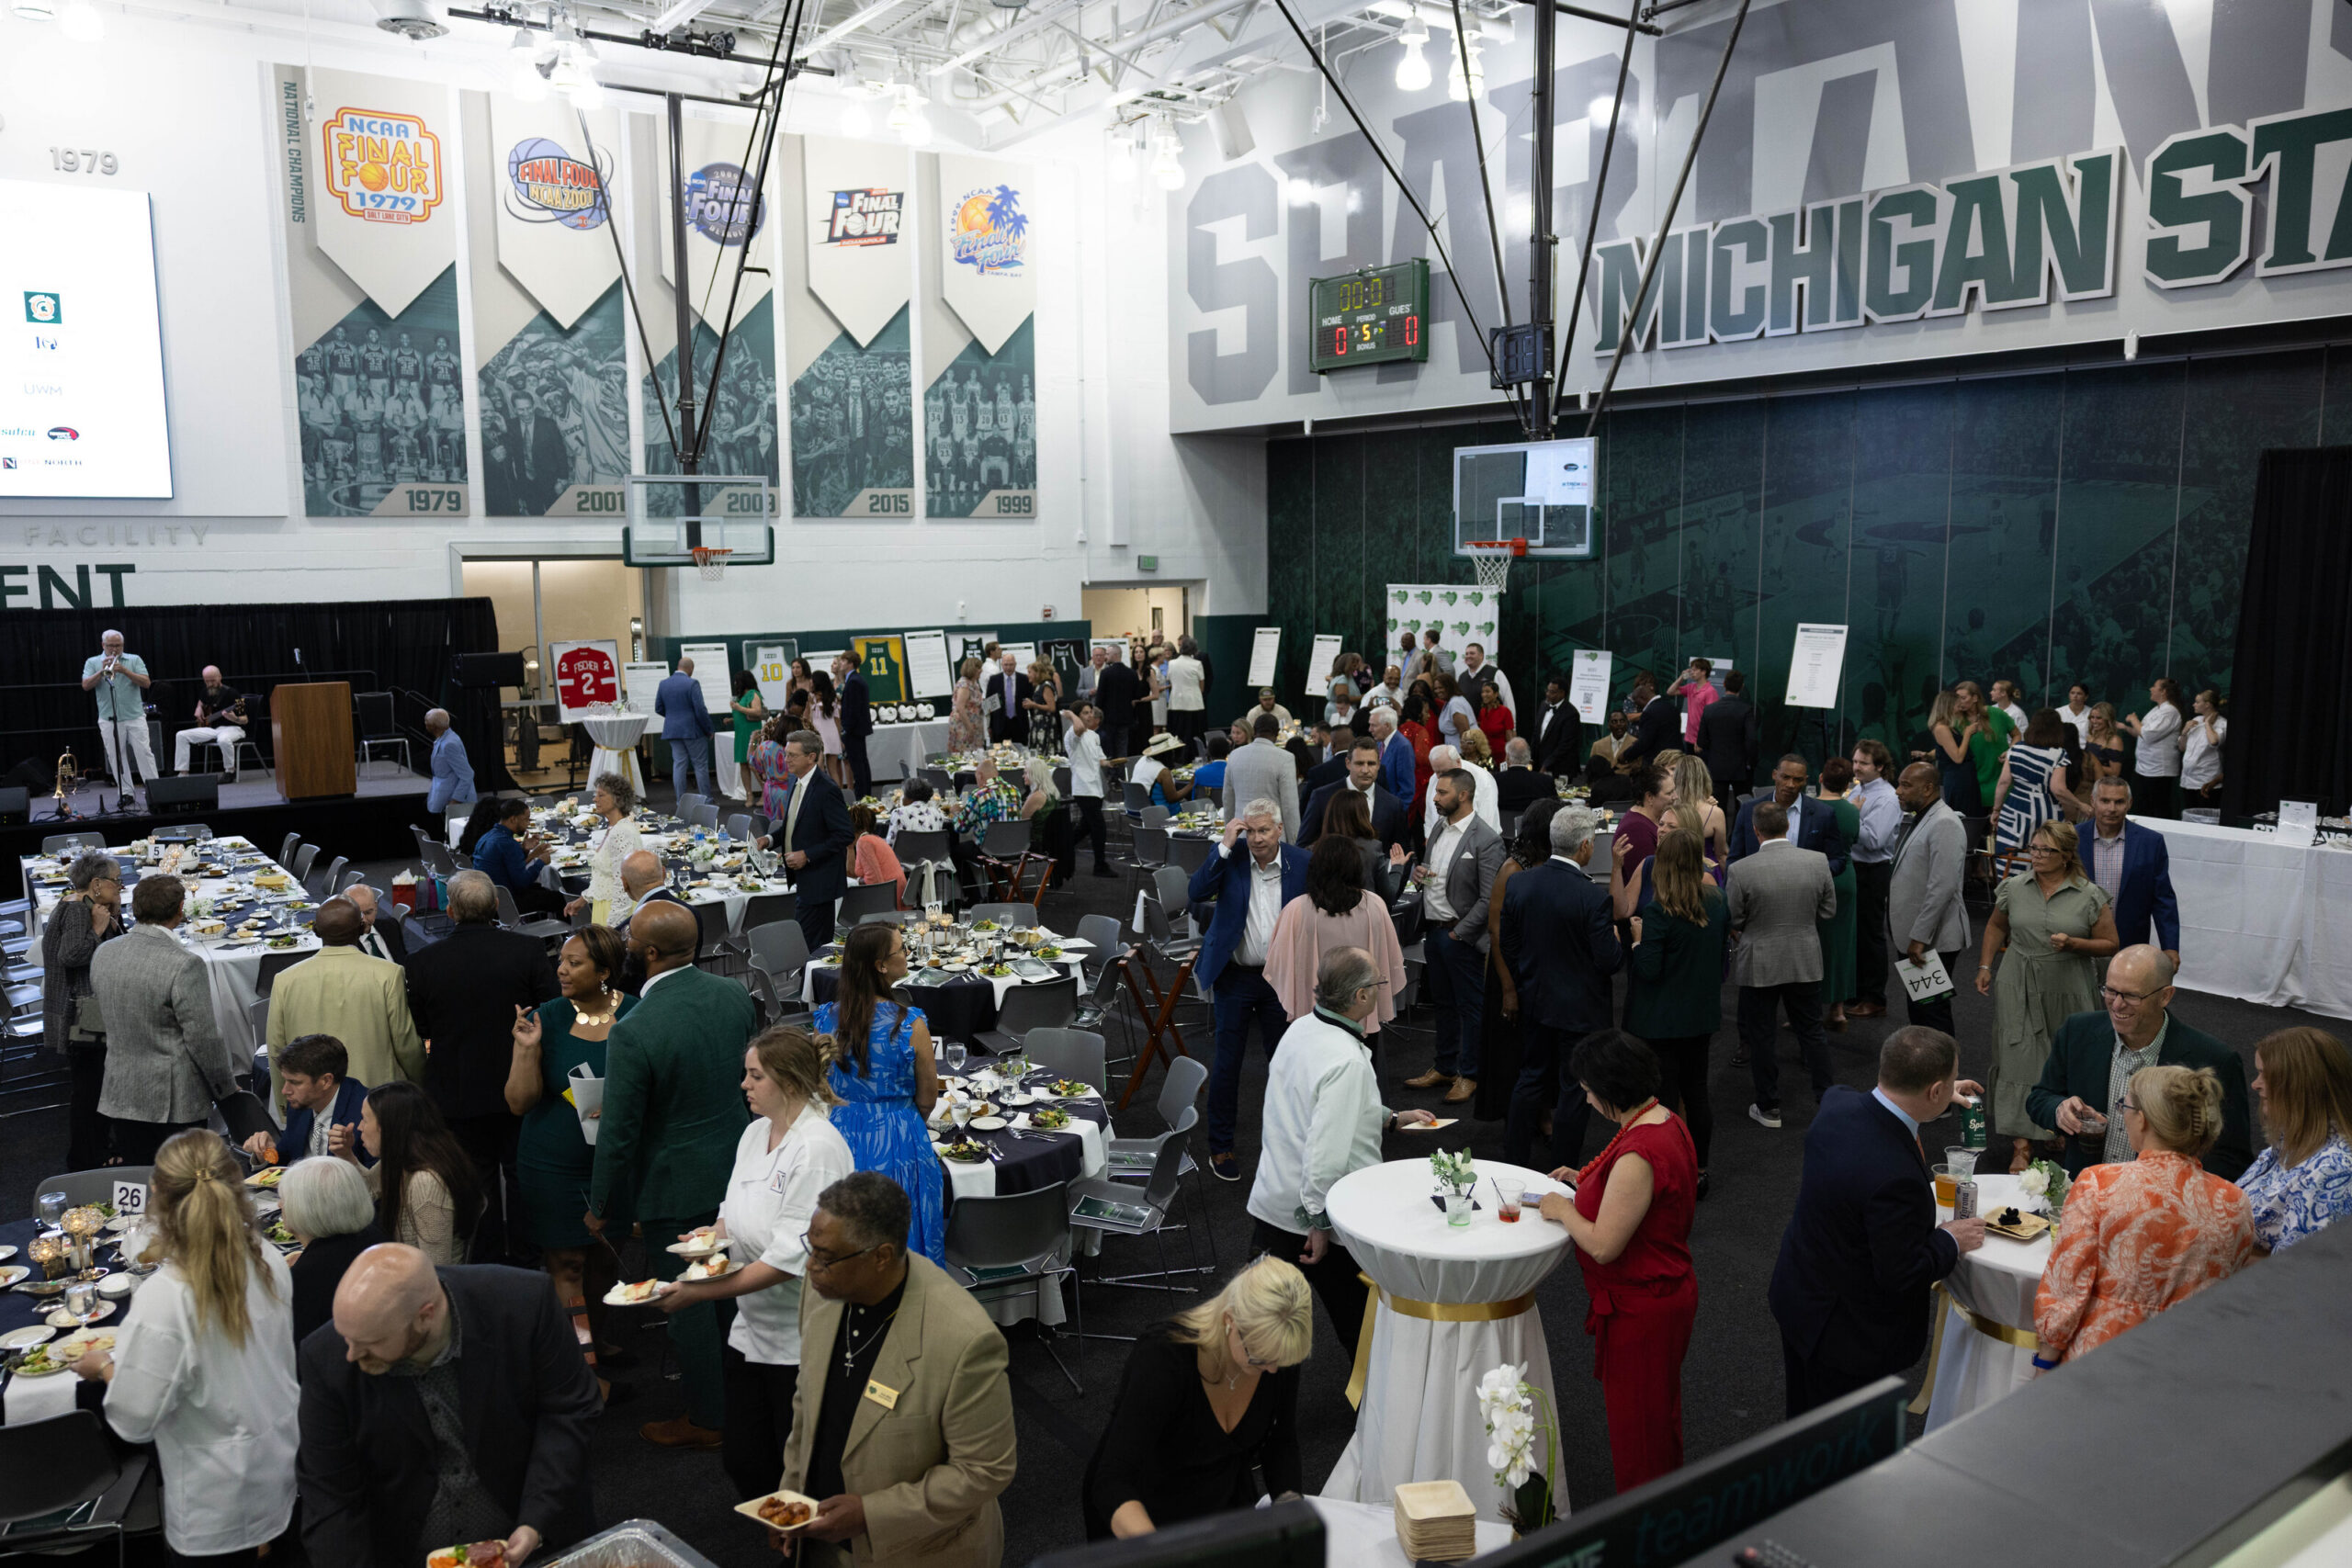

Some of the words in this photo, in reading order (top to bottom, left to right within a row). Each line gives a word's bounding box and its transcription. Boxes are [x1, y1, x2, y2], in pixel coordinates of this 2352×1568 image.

[283, 81, 300, 144] NATIONAL
[349, 117, 409, 138] NCAA
[50, 146, 119, 176] 1979
[336, 132, 428, 169] FINAL
[340, 159, 429, 195] FOUR
[519, 159, 560, 186] FINAL
[561, 161, 600, 188] FOUR
[288, 148, 305, 223] CHAMPIONS
[963, 188, 993, 201] NCAA
[2145, 107, 2352, 282] ST
[356, 191, 416, 211] 1979
[529, 185, 562, 209] NCAA
[563, 189, 594, 209] 2001
[851, 192, 899, 213] FINAL
[950, 226, 1009, 258] Final
[1595, 150, 2117, 355] MICHIGAN
[1321, 315, 1343, 327] HOME
[1356, 313, 1376, 323] PERIOD
[1335, 326, 1347, 355] 0
[1362, 323, 1371, 341] 5
[1405, 315, 1419, 345] 0
[1356, 342, 1376, 352] BONUS
[24, 382, 62, 396] UWM
[405, 490, 461, 512] 1979
[576, 491, 625, 513] 2001
[869, 493, 910, 513] 2015
[994, 495, 1032, 514] 1999
[24, 525, 209, 547] FACILITY
[561, 662, 568, 671] 2
[603, 660, 610, 670] 2
[573, 660, 599, 673] FISCHER
[761, 663, 783, 682] 10
[870, 657, 888, 675] 11
[1060, 657, 1067, 671] 1
[582, 672, 595, 694] 2
[153, 846, 160, 856] 5
[1908, 969, 1946, 993] 344
[118, 1186, 141, 1208] 26
[1633, 1410, 1882, 1565] teamwork
